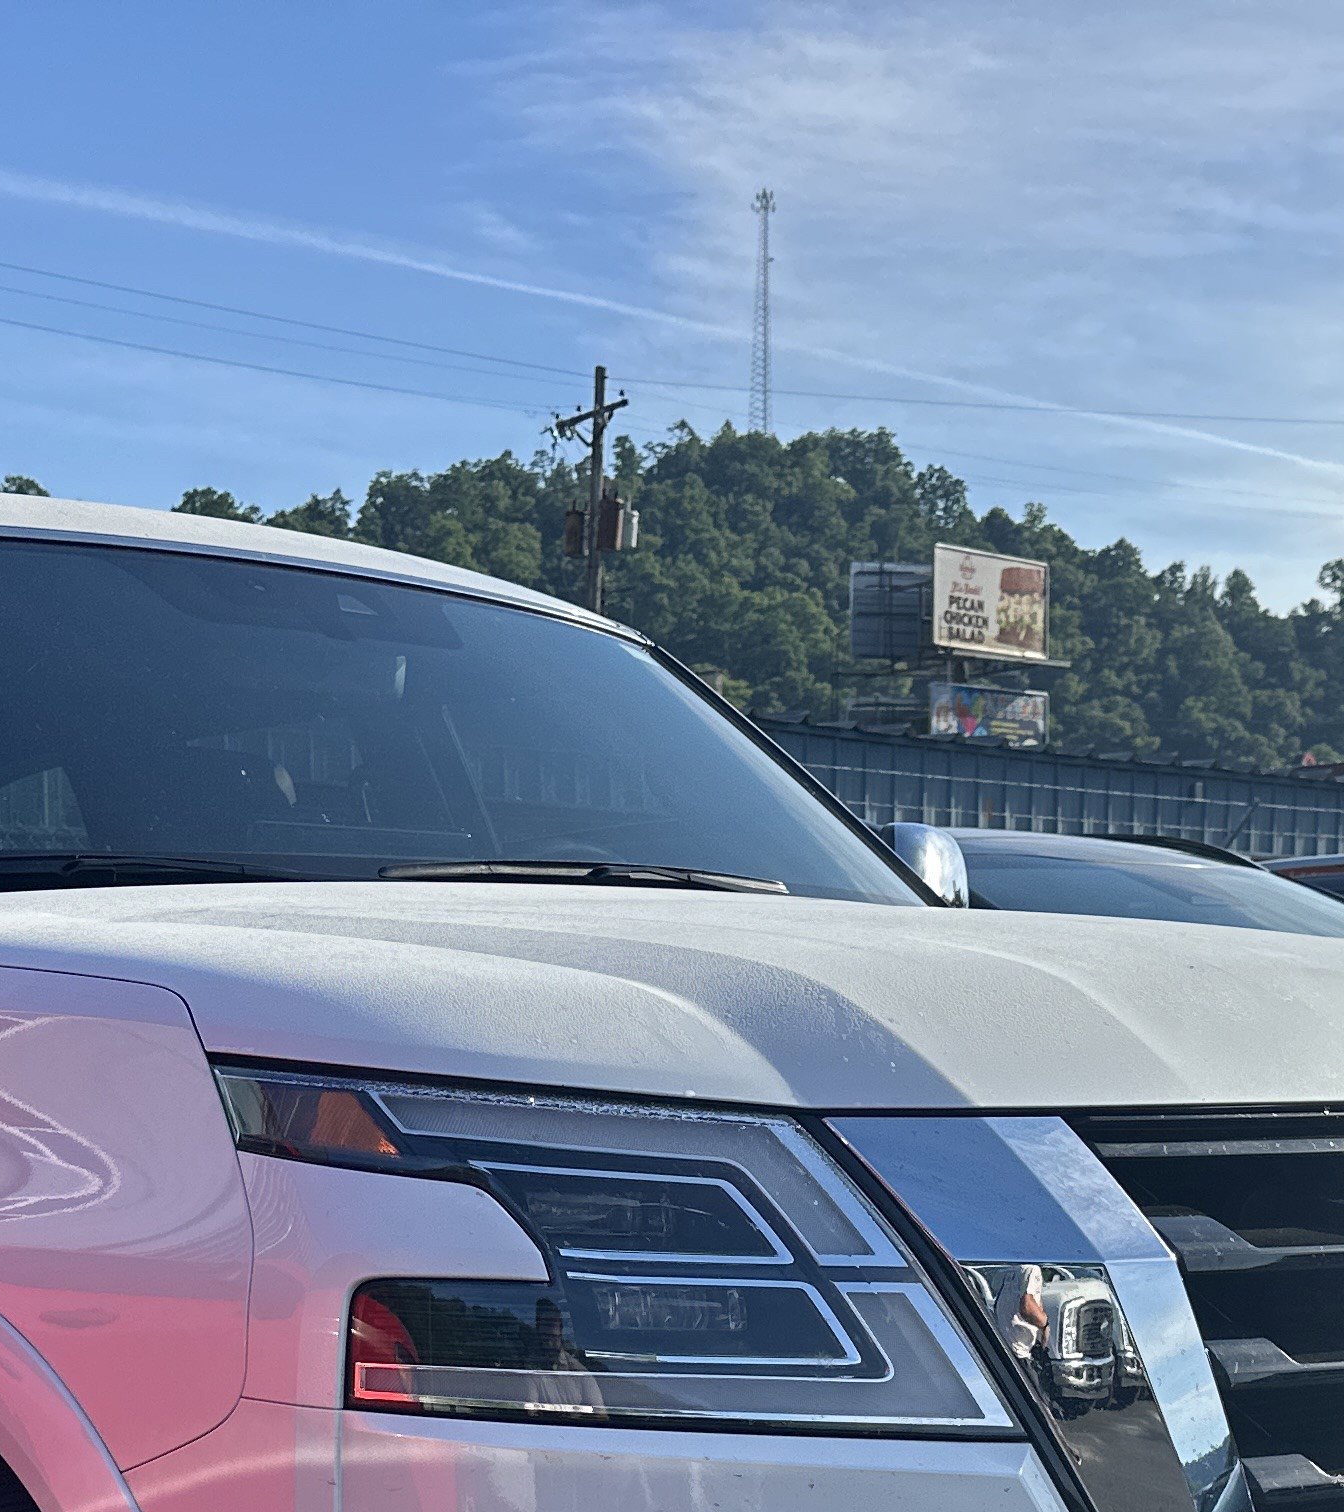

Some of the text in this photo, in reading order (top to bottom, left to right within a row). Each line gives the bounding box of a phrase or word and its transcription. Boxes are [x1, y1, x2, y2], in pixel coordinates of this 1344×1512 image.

[948, 595, 985, 613] PECAN
[943, 610, 989, 630] CHICKEN
[948, 626, 986, 644] SALAD
